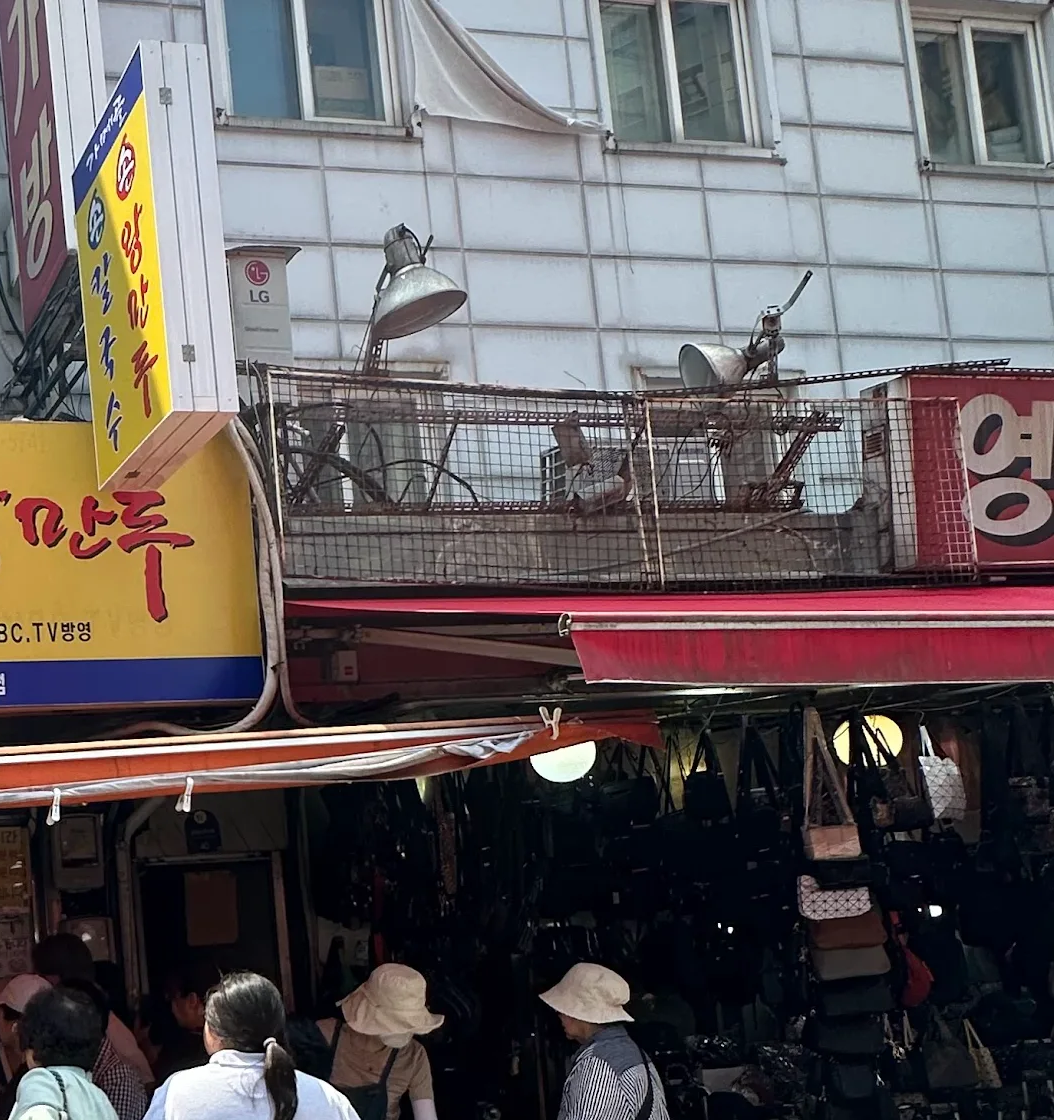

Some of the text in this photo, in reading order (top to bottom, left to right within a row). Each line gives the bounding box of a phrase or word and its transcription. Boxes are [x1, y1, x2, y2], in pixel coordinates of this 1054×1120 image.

[7, 0, 53, 280] 가방
[90, 252, 119, 451] 칼국수
[121, 202, 159, 418] 왕만두
[249, 290, 270, 303] LG
[955, 393, 1054, 537] 영
